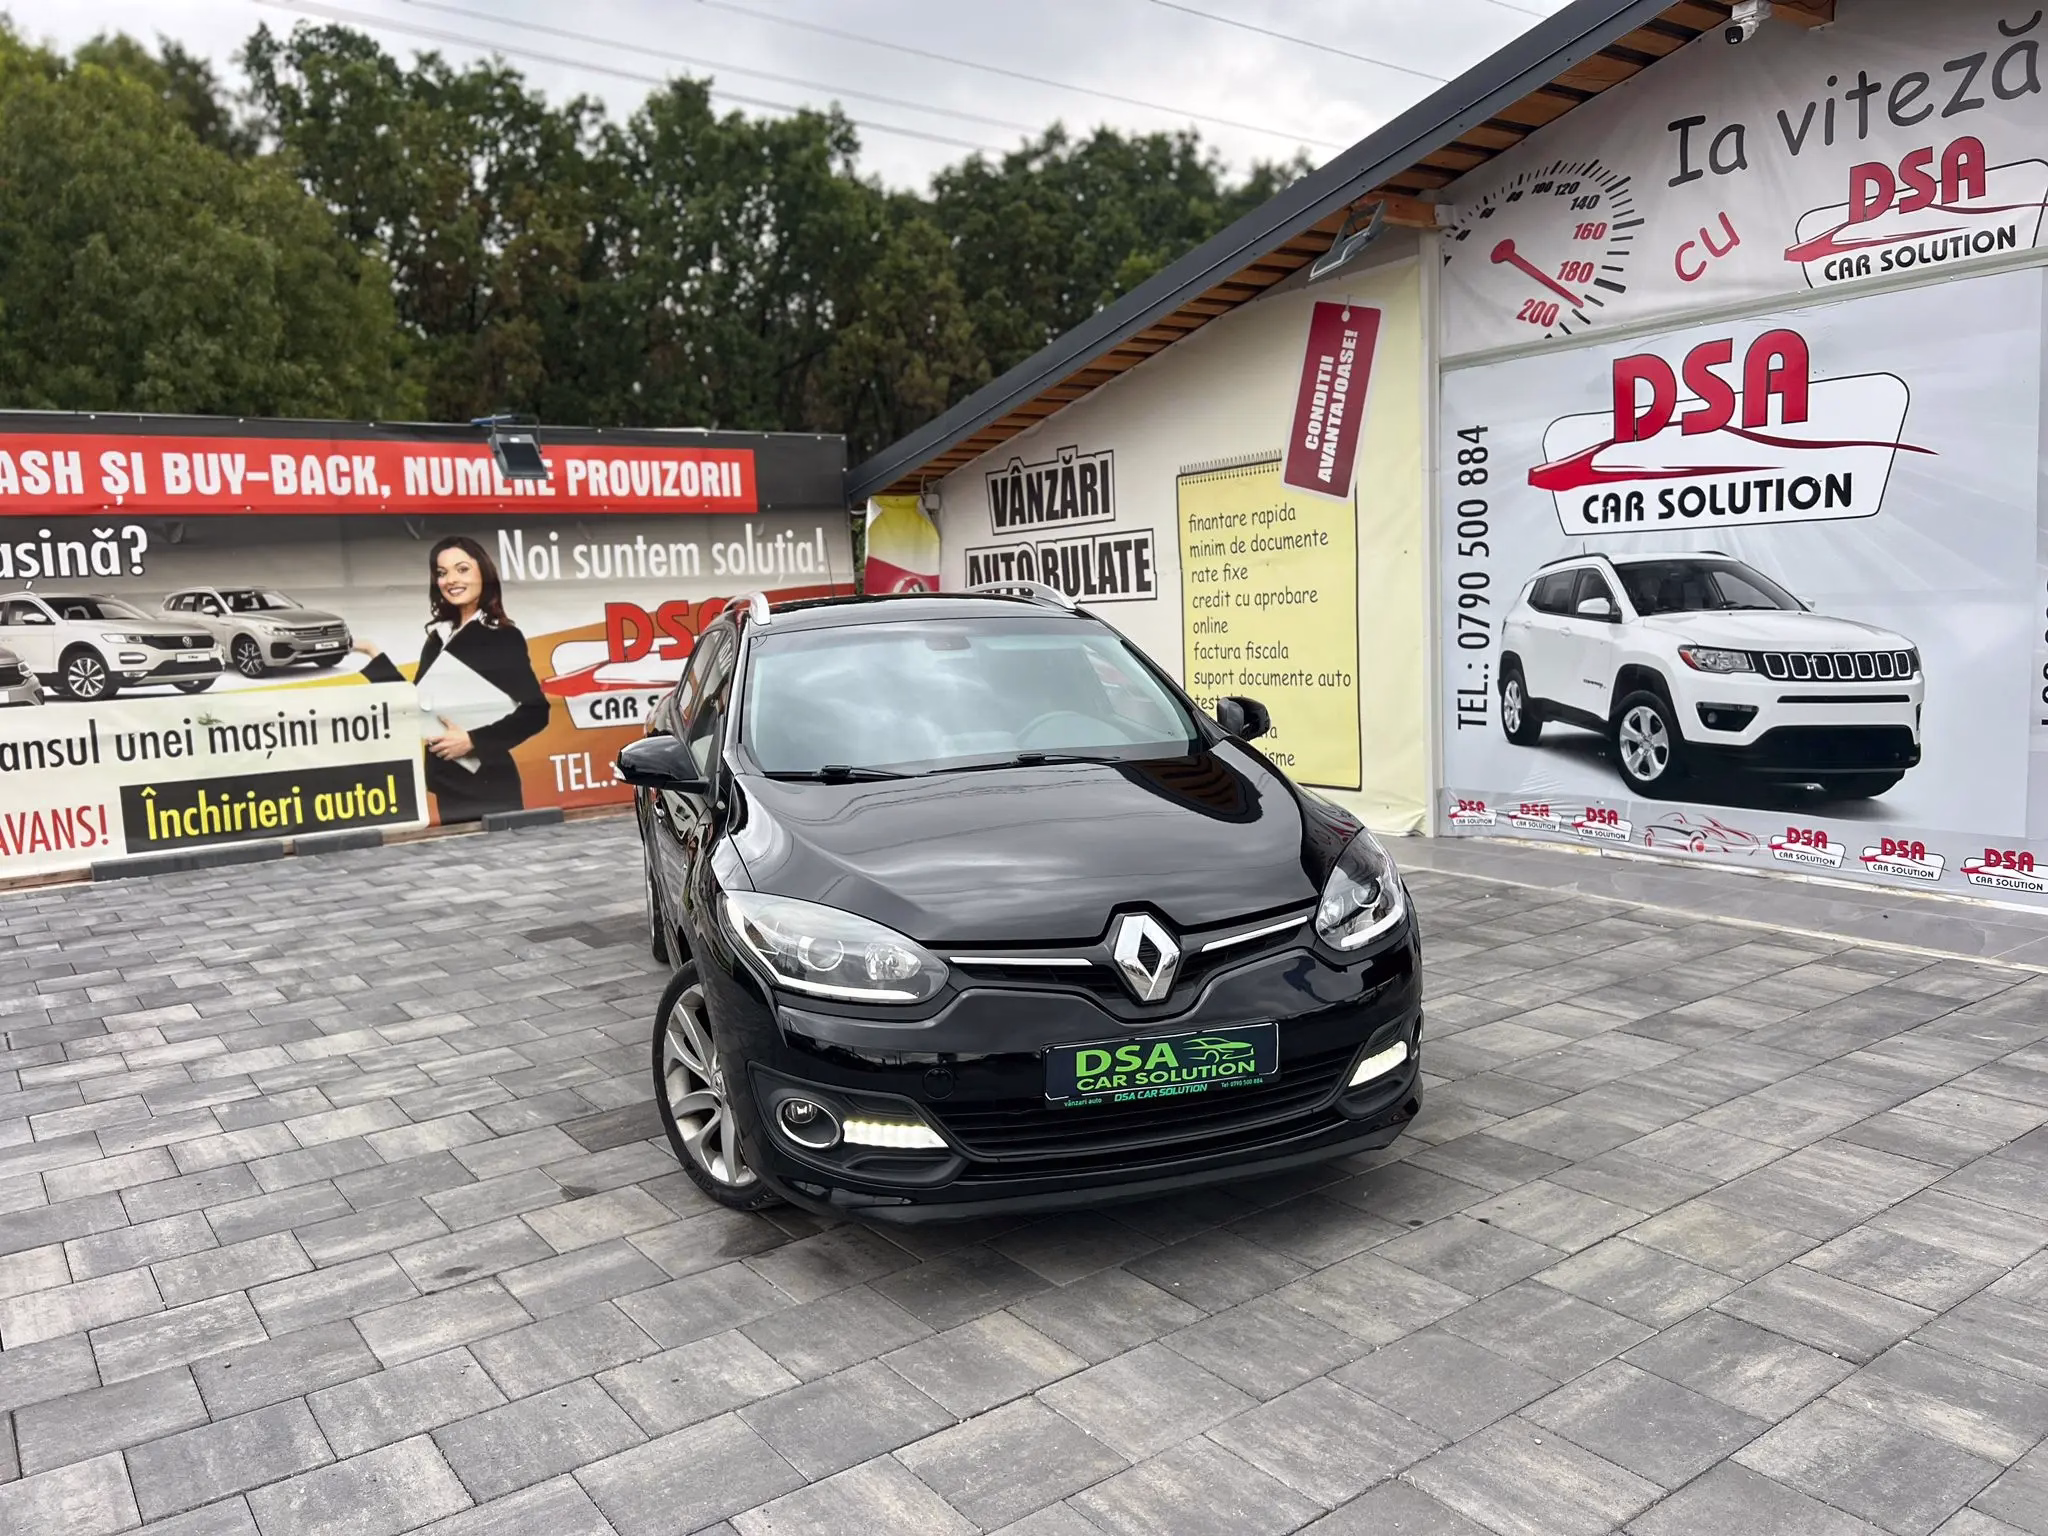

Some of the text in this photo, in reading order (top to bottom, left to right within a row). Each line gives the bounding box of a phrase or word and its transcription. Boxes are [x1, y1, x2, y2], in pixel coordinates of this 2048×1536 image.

[1667, 11, 2044, 188] Ia viteză
[1554, 181, 1581, 196] 120
[1848, 136, 1987, 225] DSA
[1570, 194, 1600, 211] 140
[1572, 222, 1607, 240] 160
[1674, 211, 1741, 282] cu
[1824, 224, 2016, 282] CAR SOLUTION
[1557, 260, 1595, 283] 180
[1516, 298, 1559, 327] 200
[1613, 328, 1809, 444] DSA
[1305, 355, 1334, 450] CONDITII
[1318, 329, 1359, 483] AVANTAJOASE!
[0, 450, 84, 495] ASH
[100, 451, 147, 506] ȘI
[162, 452, 390, 499] BUY-BACK,
[567, 459, 742, 498] PROVIZORII
[991, 455, 1110, 528] VÂNZĂRI
[1582, 472, 1853, 525] CAR SOLUTION
[1188, 502, 1296, 533] finantare rapida
[498, 523, 826, 583] Noi suntem soluția!
[1189, 529, 1329, 558] minim de documente
[1041, 538, 1152, 597] RULATE
[1192, 563, 1249, 583] rate fixe
[1457, 424, 1491, 730] TEL.: 0790 500 884
[1192, 586, 1319, 611] credit cu aprobare
[1193, 616, 1229, 634] online
[1194, 640, 1289, 660] factura fiscala
[1194, 668, 1351, 690] suport documente auto
[589, 696, 639, 720] CAR
[0, 702, 391, 772] ansul unei mașini noi!
[140, 775, 398, 840] Închirieri auto!
[1586, 807, 1619, 825] DSA
[1594, 830, 1626, 840] SOLUTION
[1786, 826, 1828, 849] DSA
[1881, 837, 1926, 861] DSA
[1778, 852, 1836, 866] CAR SOLUTION
[1872, 864, 1934, 878] CAR SOLUTION
[1984, 848, 2035, 872] DSA
[1975, 876, 2044, 891] CAR SOLUTION
[1076, 1042, 1179, 1077] DSA
[1076, 1059, 1255, 1091] CAR SOLUTION
[1114, 1092, 1136, 1102] DSA
[1137, 1089, 1159, 1099] CAR
[1159, 1083, 1208, 1098] SOLUTION
